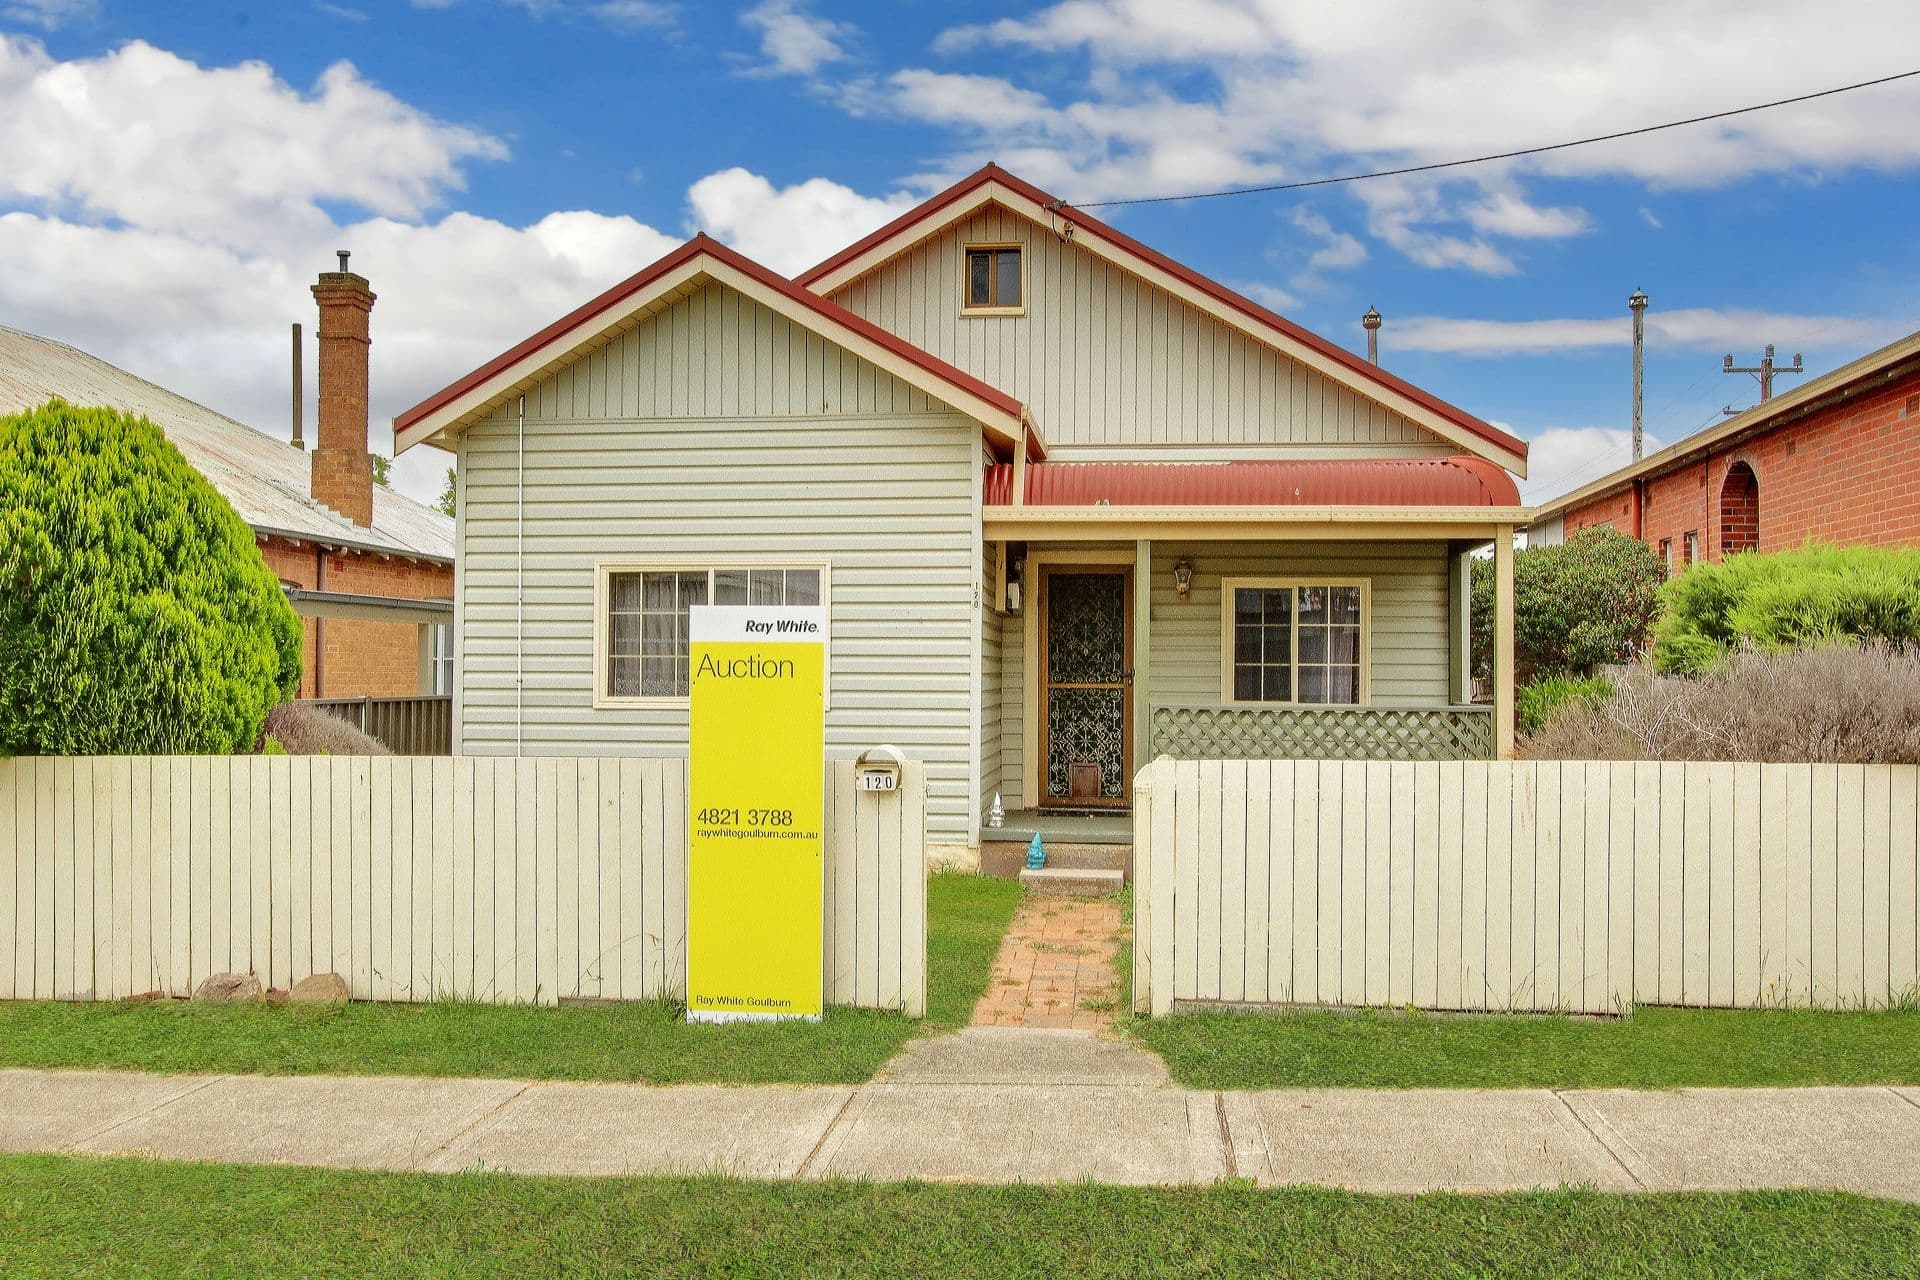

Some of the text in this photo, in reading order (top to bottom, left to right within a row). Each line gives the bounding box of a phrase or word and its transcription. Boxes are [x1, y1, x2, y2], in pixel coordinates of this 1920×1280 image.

[745, 619, 774, 635] Ray
[696, 653, 794, 679] Auction
[865, 776, 892, 790] 120
[697, 807, 793, 827] 4821 3788
[697, 827, 818, 840] raywhitegoulburn.com.au
[696, 994, 791, 1008] Ray White Goulburn
